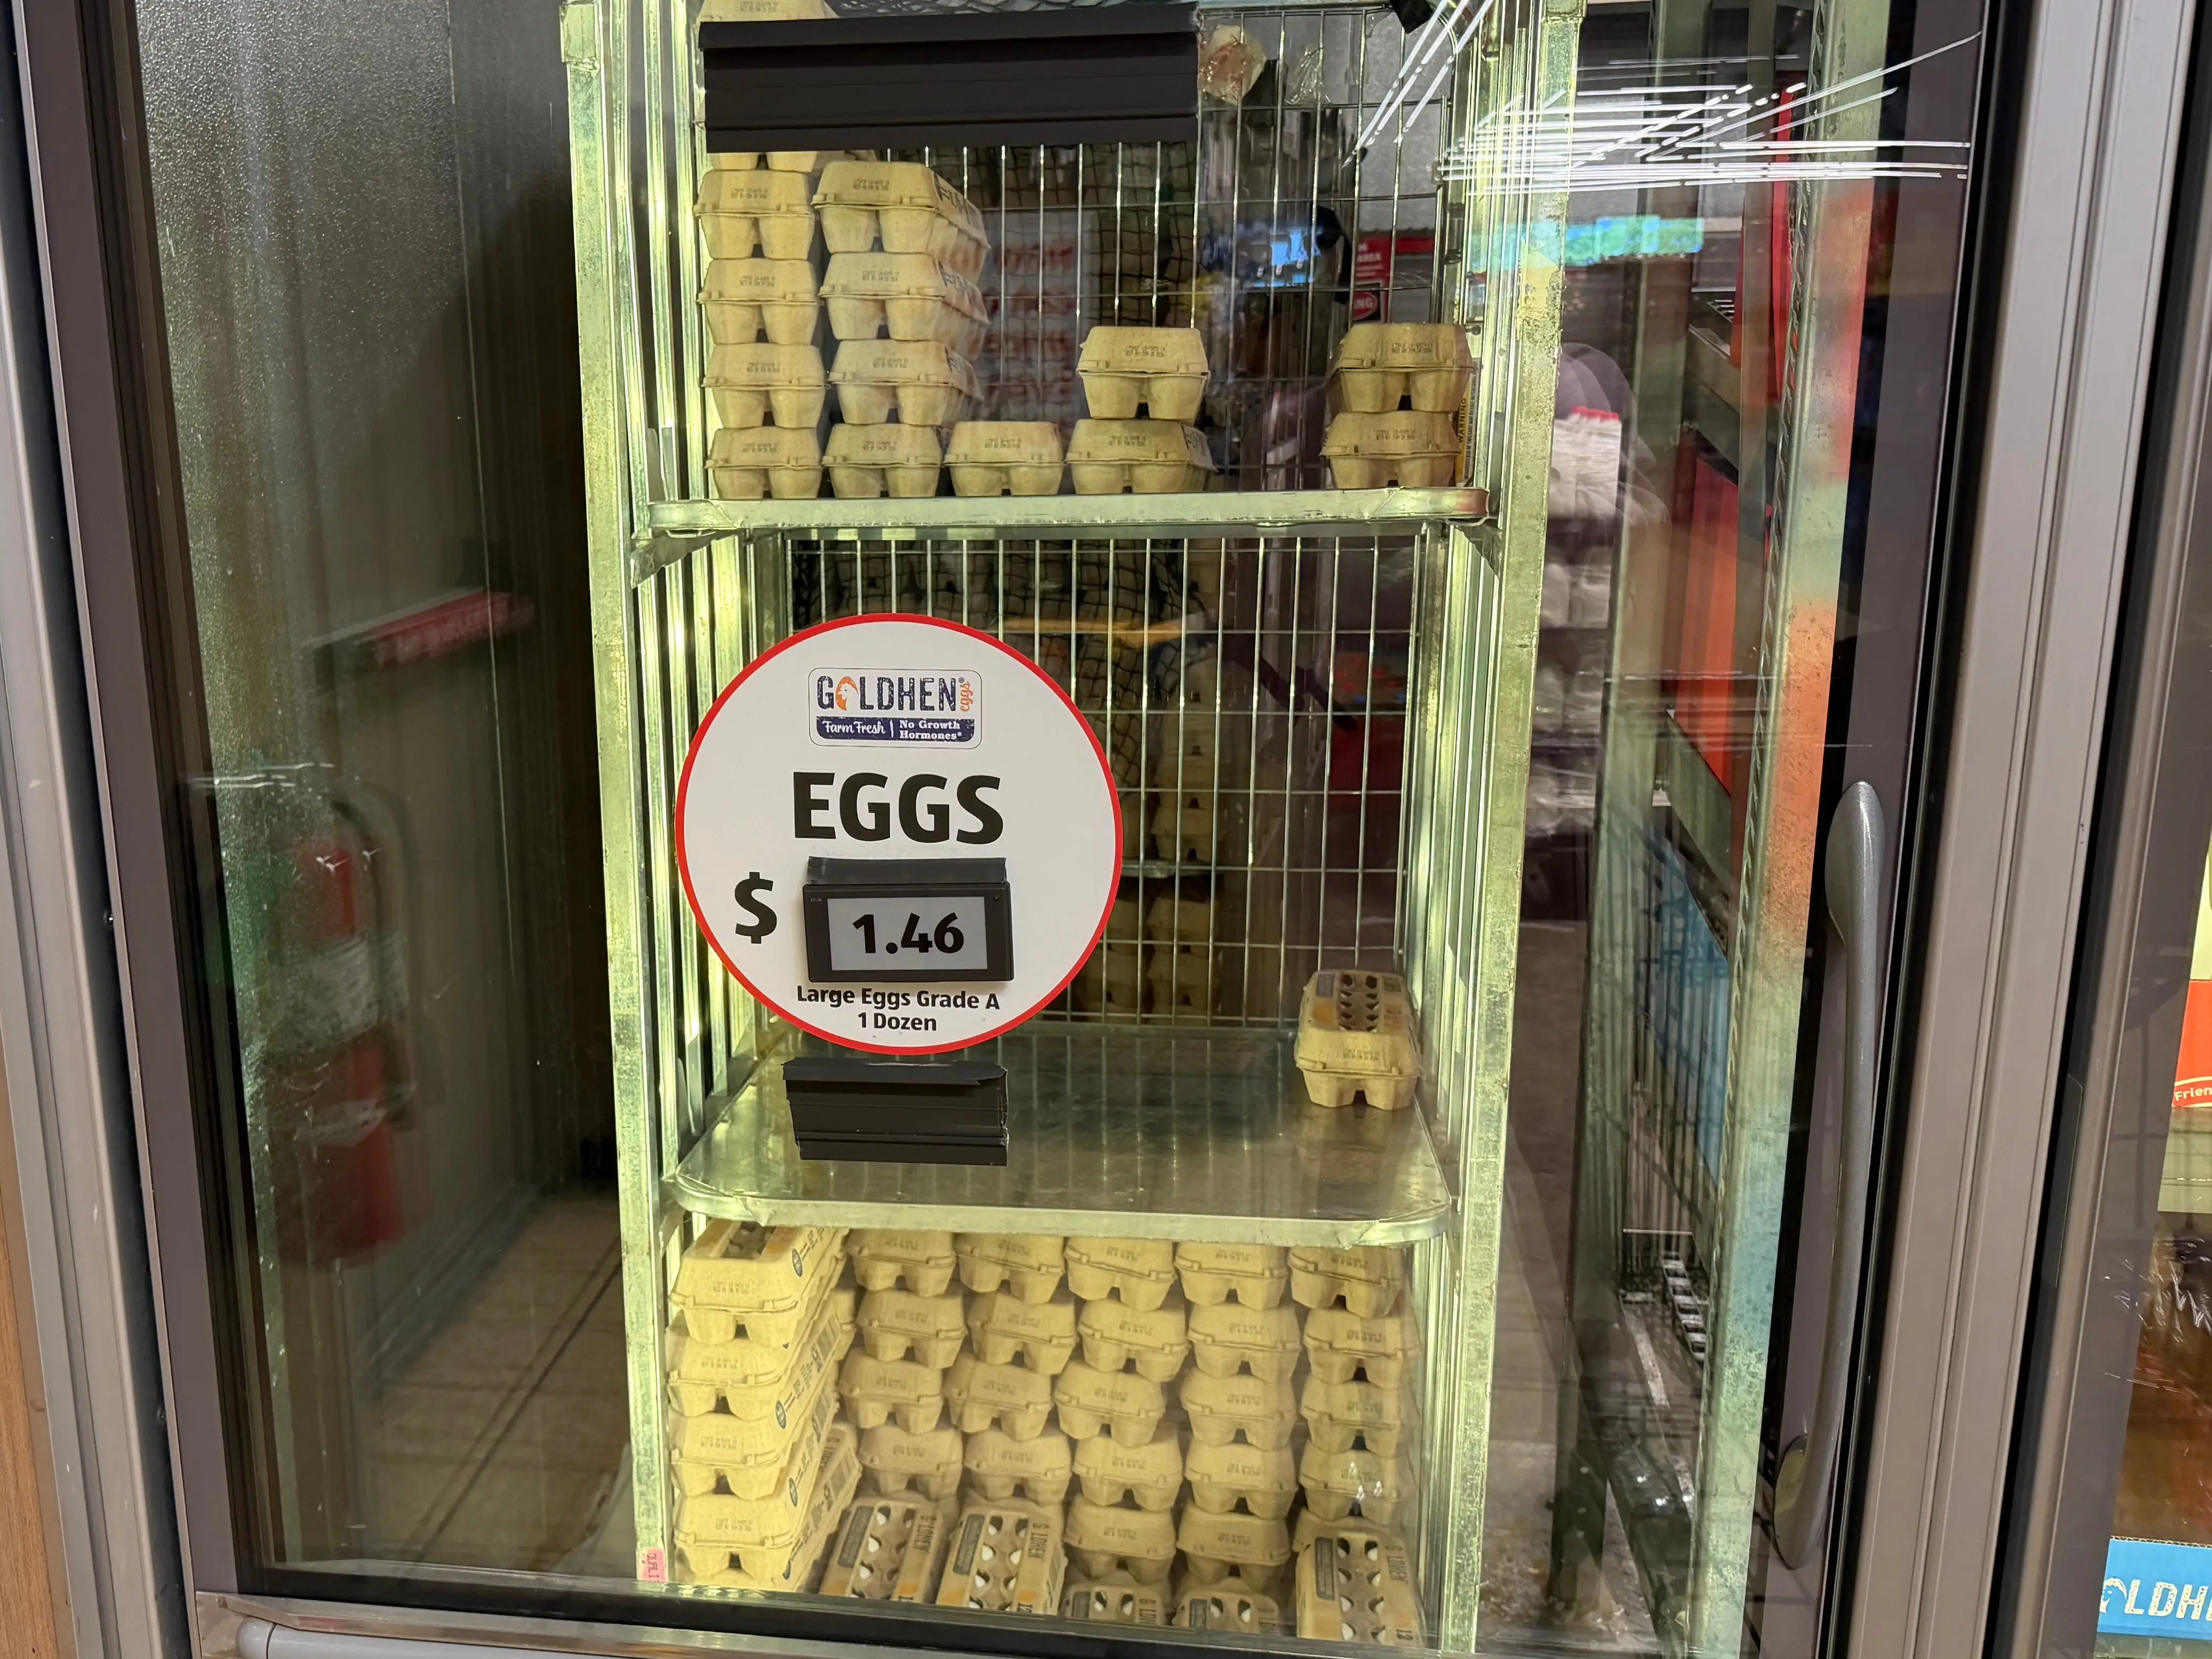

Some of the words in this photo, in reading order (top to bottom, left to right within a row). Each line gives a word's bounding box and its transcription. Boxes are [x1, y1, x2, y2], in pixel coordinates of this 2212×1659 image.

[1458, 398, 1467, 443] WARNING
[960, 681, 975, 712] eggs
[822, 720, 855, 734] Farm
[854, 721, 886, 734] Fresh
[899, 720, 915, 729] No
[918, 720, 960, 729] Growth
[793, 772, 1003, 845] EGGS
[734, 872, 777, 944] $
[852, 912, 964, 955] 1.46
[797, 985, 855, 1008] Large
[861, 988, 911, 1010] Eggs
[917, 990, 980, 1009] Grade
[985, 993, 1000, 1010] A
[858, 1012, 867, 1028] 1
[874, 1013, 937, 1031] Dozen
[1396, 1628, 1414, 1641] 12
